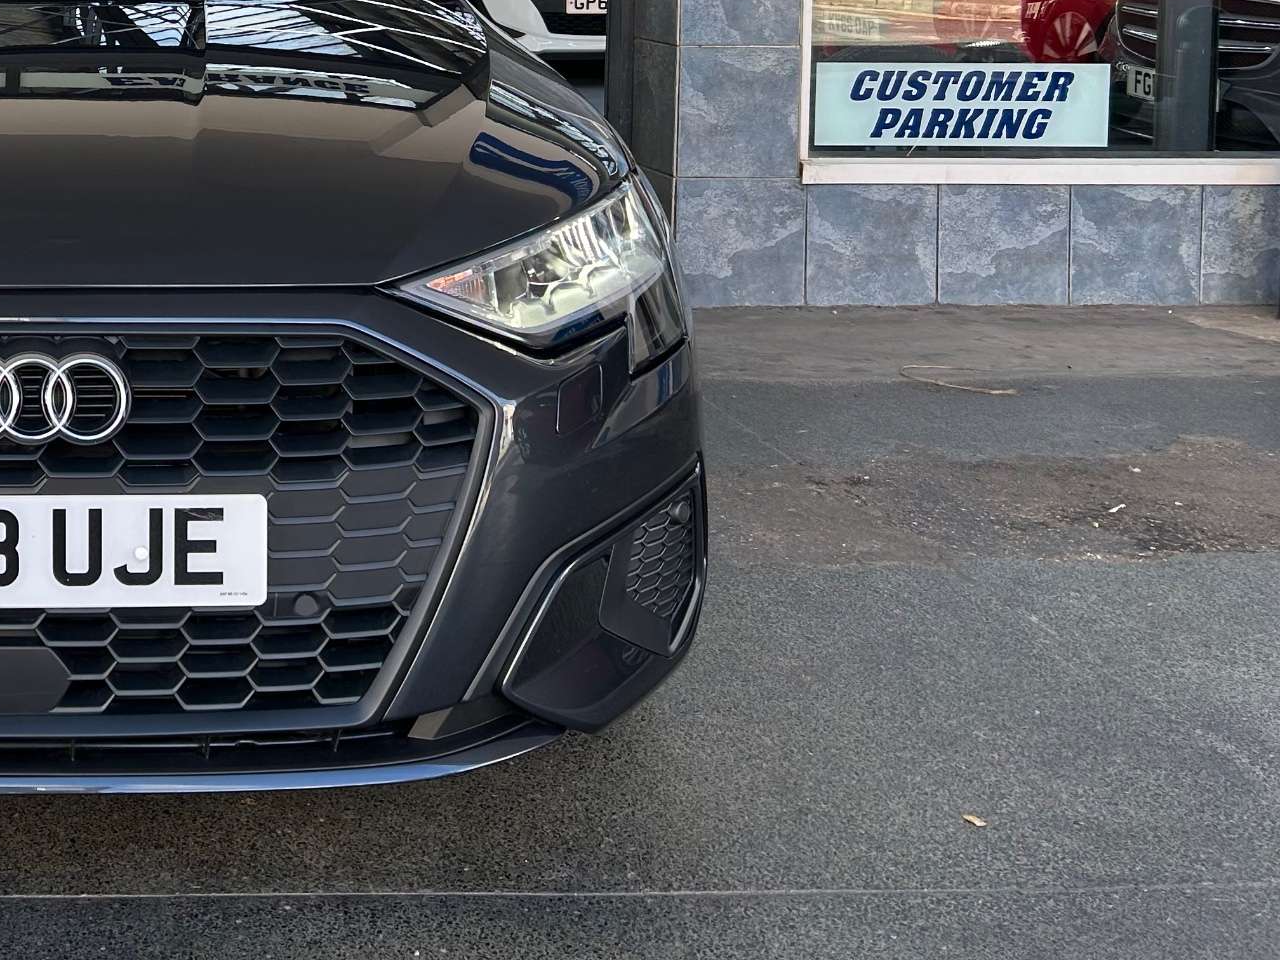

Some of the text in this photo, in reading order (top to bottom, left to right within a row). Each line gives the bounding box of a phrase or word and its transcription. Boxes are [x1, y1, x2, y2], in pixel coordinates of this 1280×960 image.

[849, 70, 1075, 102] CUSTOMER
[870, 108, 1053, 140] PARKING
[52, 507, 224, 586] UJE
